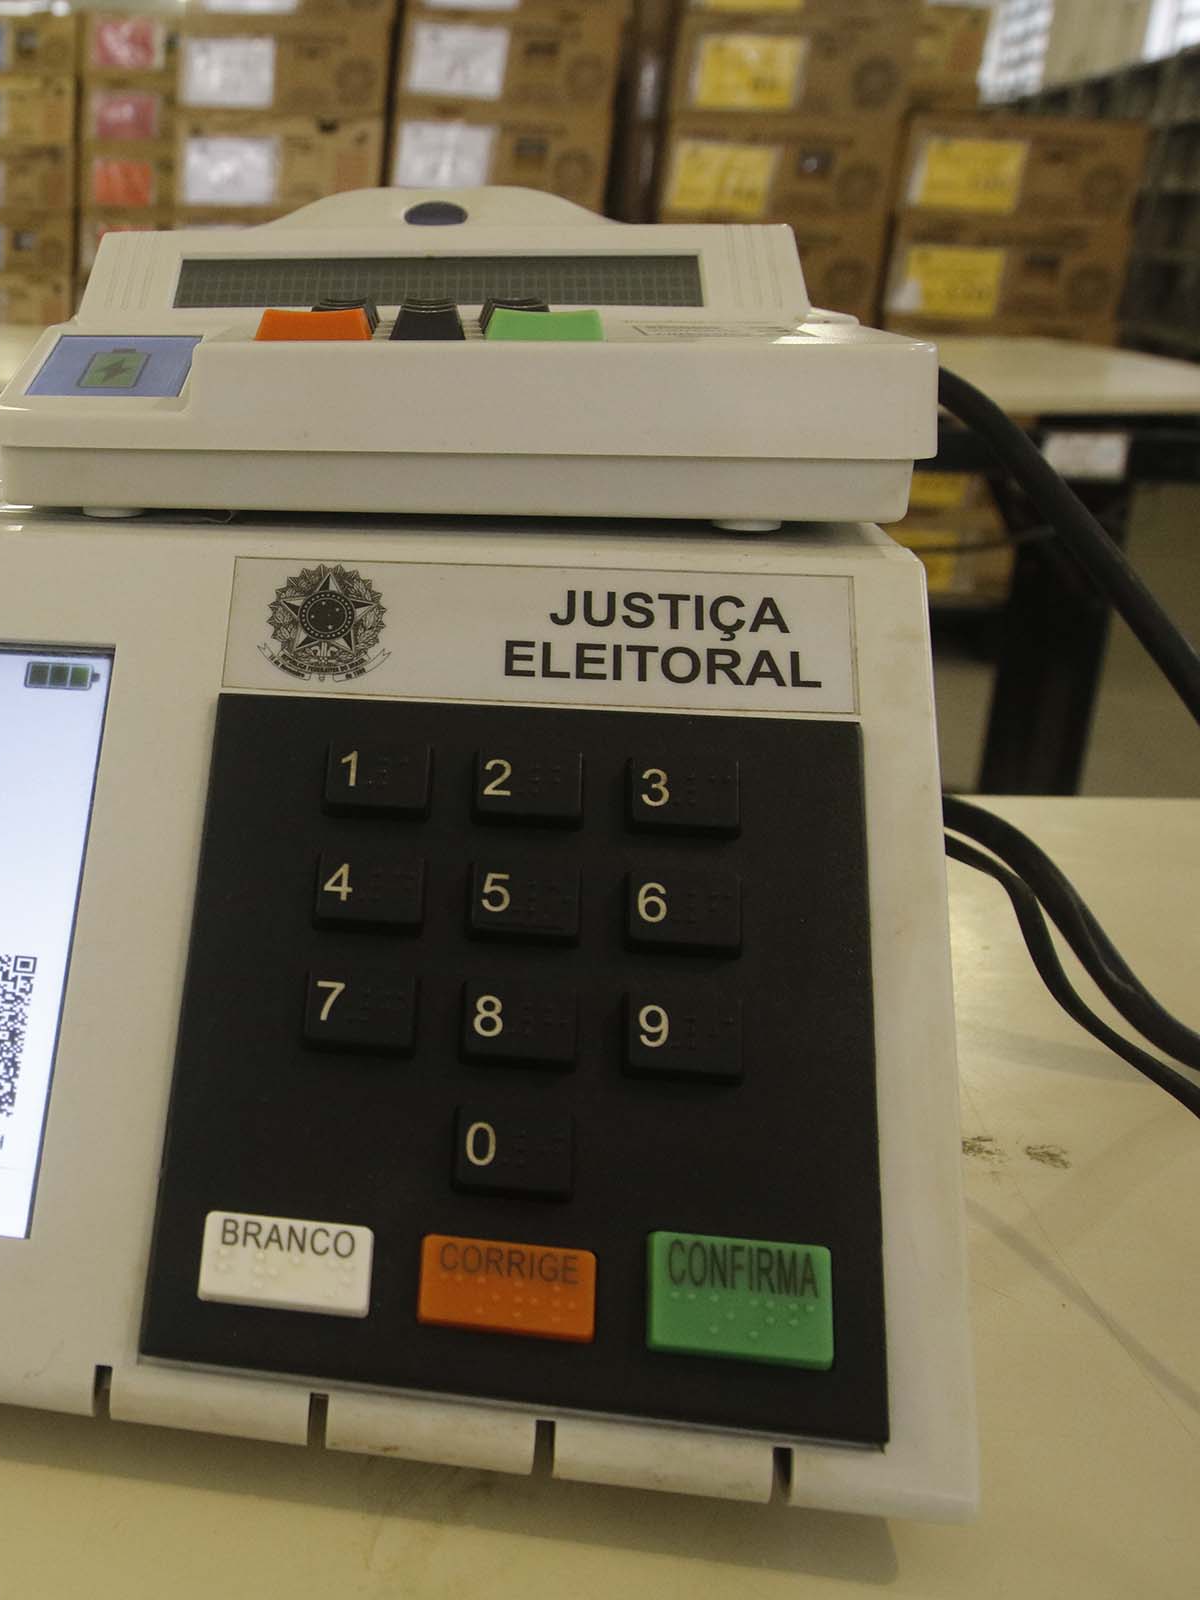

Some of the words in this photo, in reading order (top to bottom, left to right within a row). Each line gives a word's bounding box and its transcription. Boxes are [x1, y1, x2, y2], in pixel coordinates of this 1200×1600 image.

[549, 589, 790, 641] JUSTIÇA
[504, 639, 822, 688] ELEITORAL
[341, 750, 360, 787] 1
[482, 759, 512, 797] 2
[641, 768, 671, 807] 3
[323, 863, 353, 901] 4
[481, 873, 511, 913] 5
[637, 882, 668, 923] 6
[316, 980, 346, 1021] 7
[472, 995, 504, 1038] 8
[638, 1004, 670, 1048] 9
[465, 1121, 497, 1166] 0
[220, 1217, 357, 1259] BRANCO
[439, 1242, 580, 1287] CORRIGE
[666, 1238, 819, 1299] CONFIRMA
